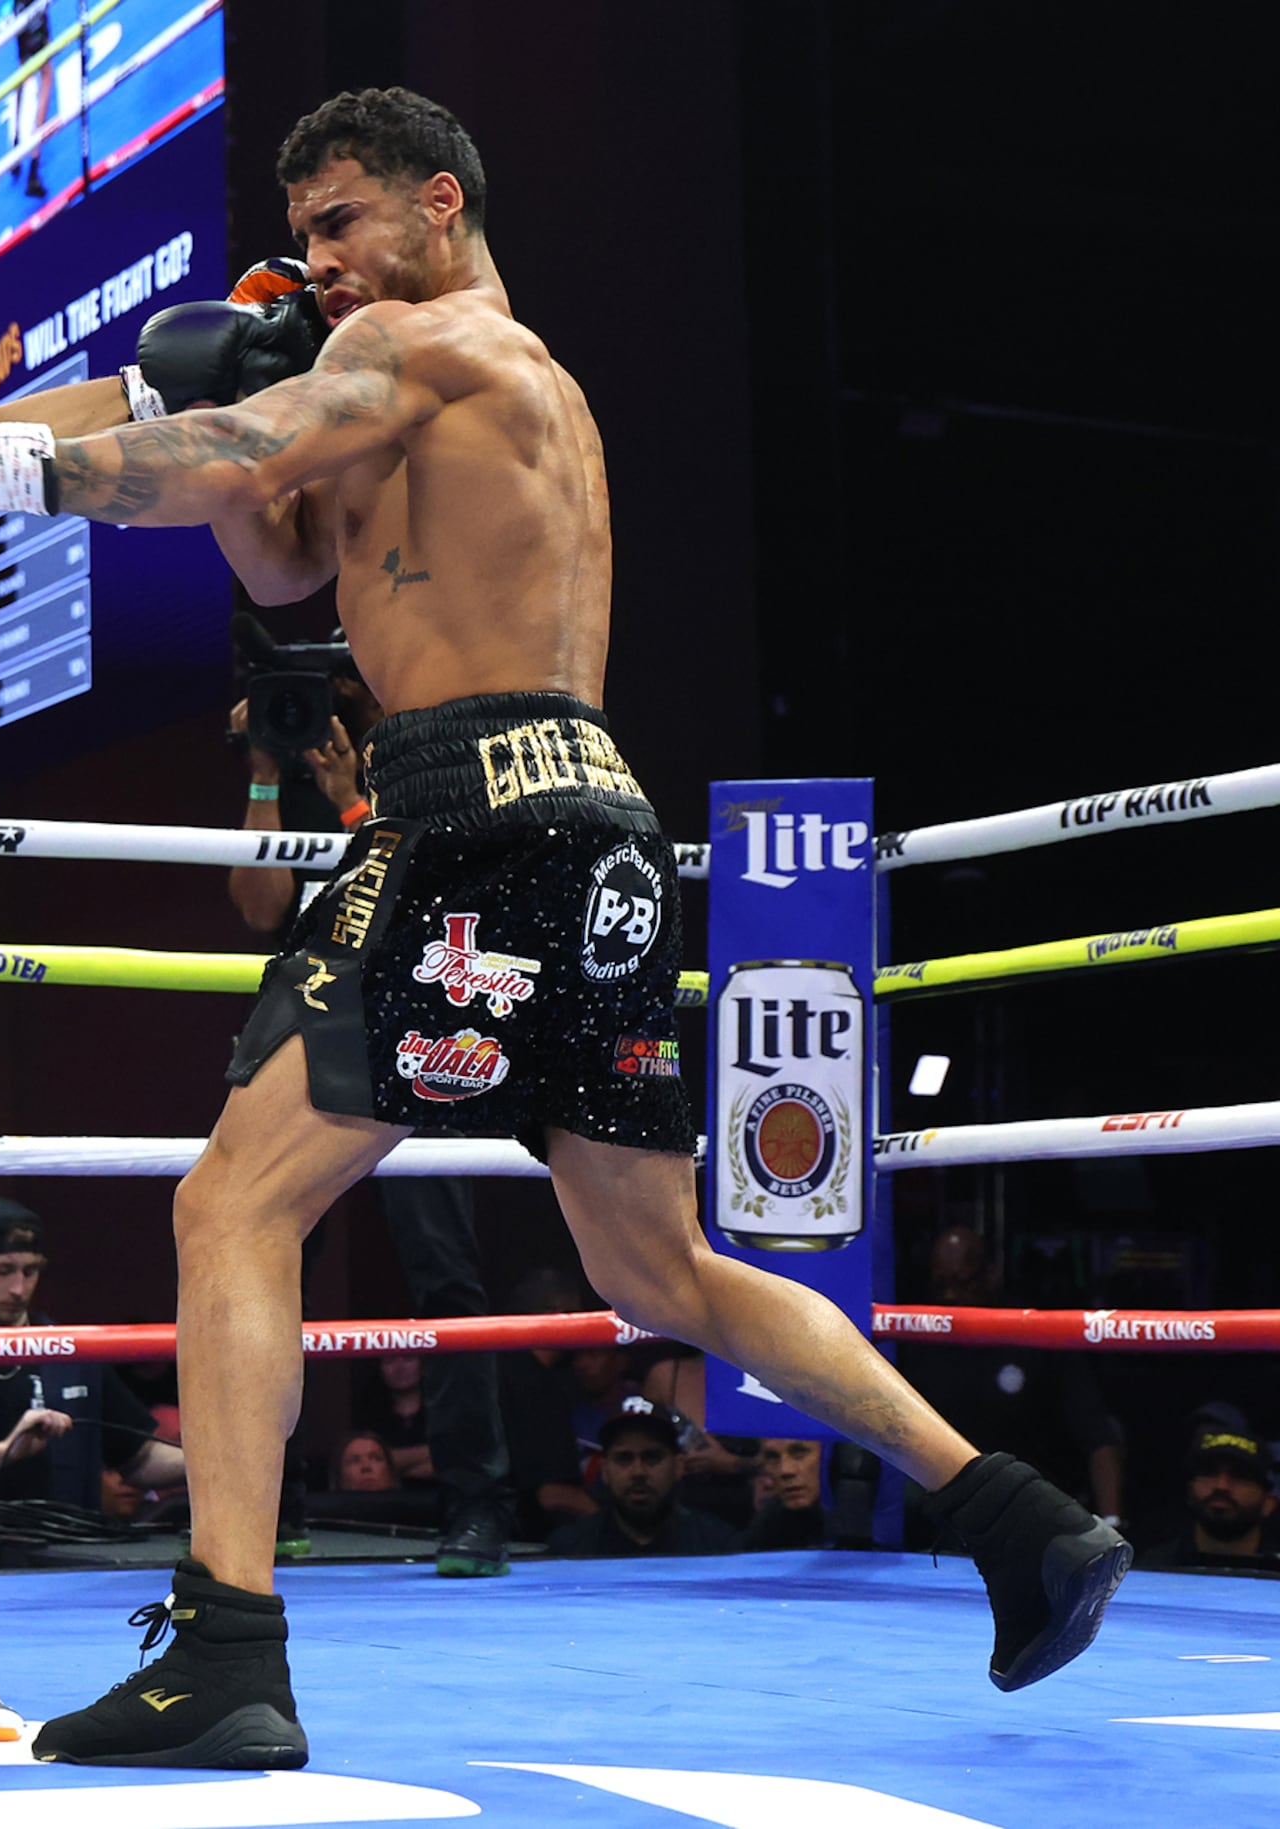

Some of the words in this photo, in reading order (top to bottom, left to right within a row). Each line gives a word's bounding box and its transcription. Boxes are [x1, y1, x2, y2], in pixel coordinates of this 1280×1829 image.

[23, 310, 68, 371] WILL
[66, 288, 101, 345] THE
[101, 254, 154, 324] FIGHT
[154, 230, 193, 290] GO?
[1060, 794, 1121, 828] TOP
[1125, 779, 1213, 818] RANK
[255, 836, 333, 862] TOP
[740, 811, 868, 889] Lite
[593, 844, 663, 900] Merchants
[10, 955, 48, 983] TEA
[416, 943, 533, 998] Teresita
[582, 942, 639, 980] Funding
[730, 996, 851, 1077] Lite
[751, 1087, 782, 1118] FINE
[785, 1084, 834, 1134] PILSNER
[747, 1122, 757, 1133] A
[768, 1180, 813, 1196] BEER
[873, 1312, 954, 1332] AFTKINGS
[1083, 1318, 1215, 1343] DRAFTKINGS
[302, 1330, 437, 1351] RAFTKINGS
